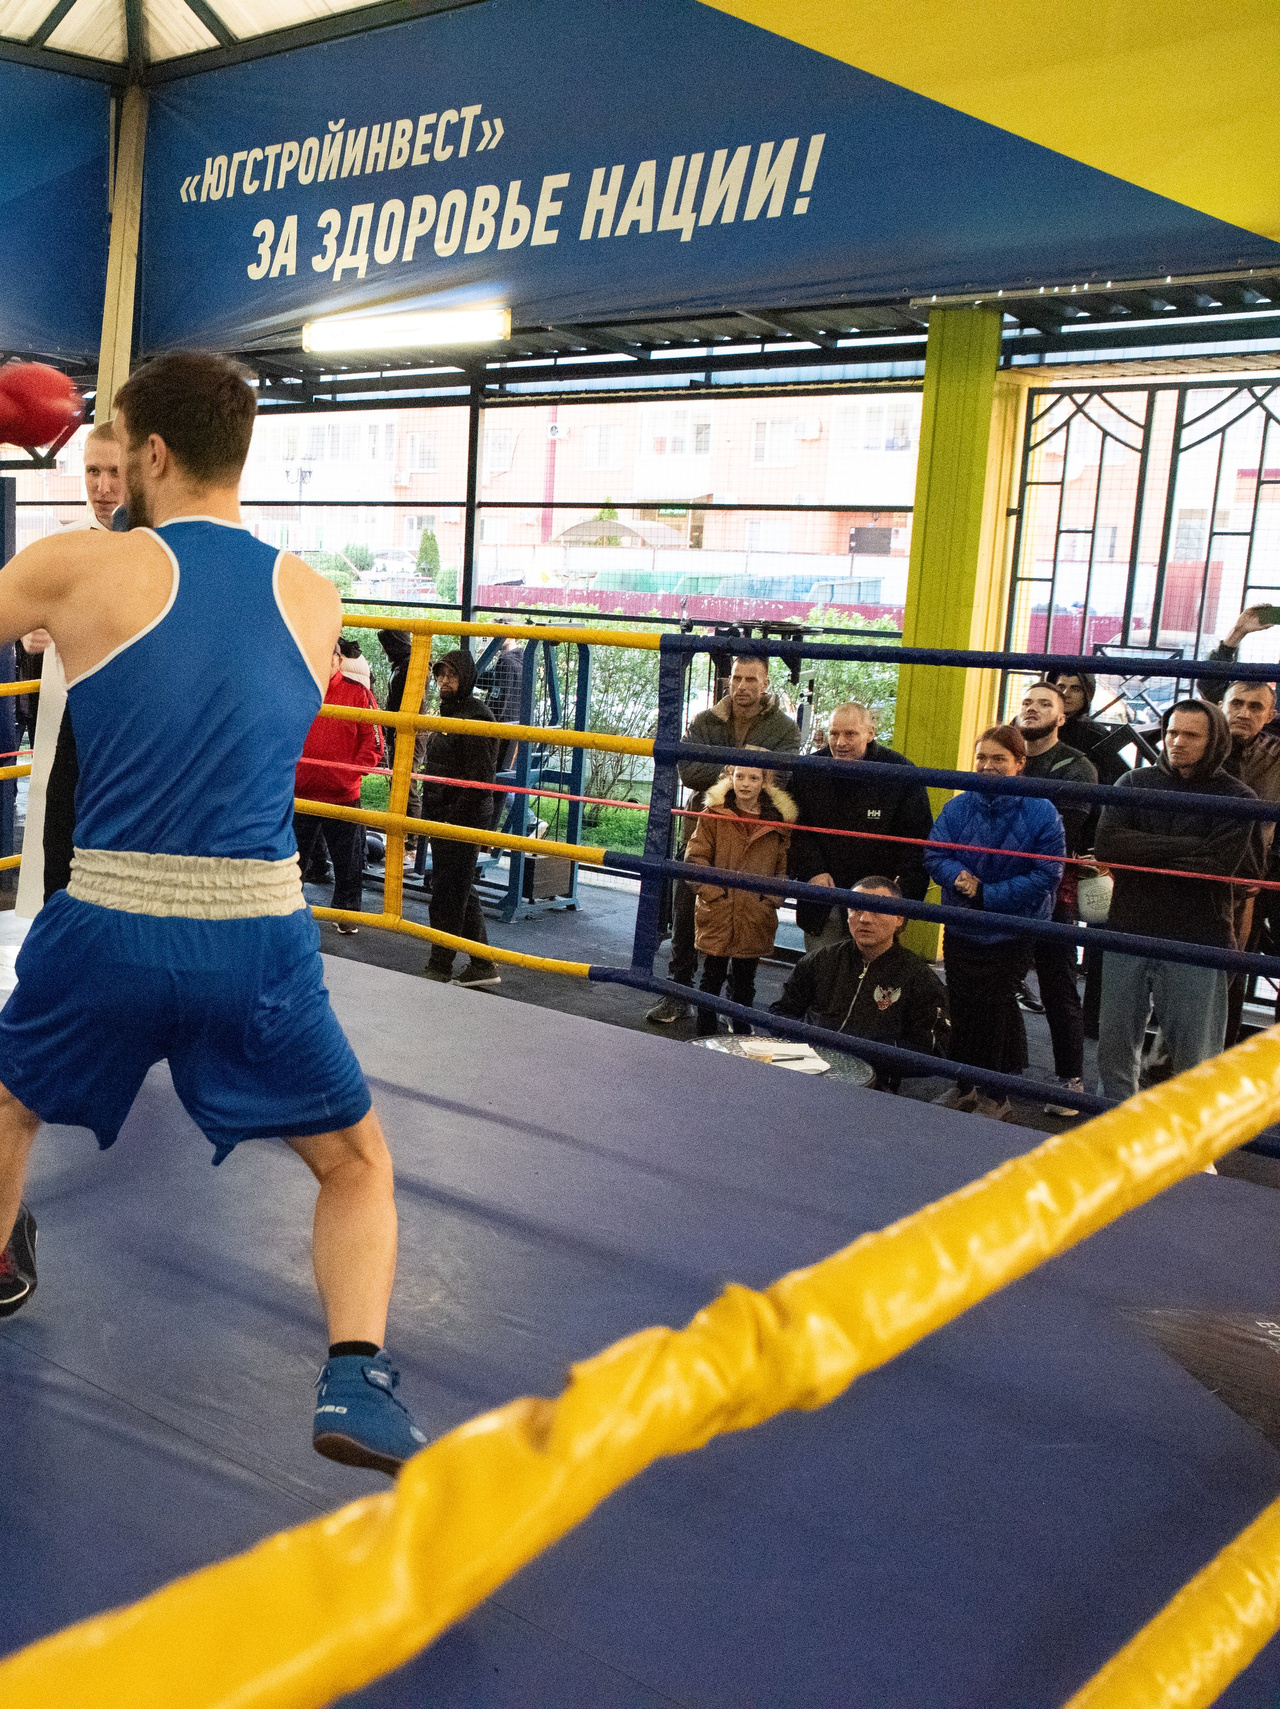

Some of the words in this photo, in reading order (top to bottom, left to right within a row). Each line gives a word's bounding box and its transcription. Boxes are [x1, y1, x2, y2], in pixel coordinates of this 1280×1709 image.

[180, 104, 505, 202] «ЮГСТРОЙИНВЕСТ»
[247, 215, 298, 280] ЗА
[312, 172, 570, 281] ЗДОРОВЬЕ
[579, 133, 826, 242] НАЦИИ!
[867, 809, 881, 817] HH
